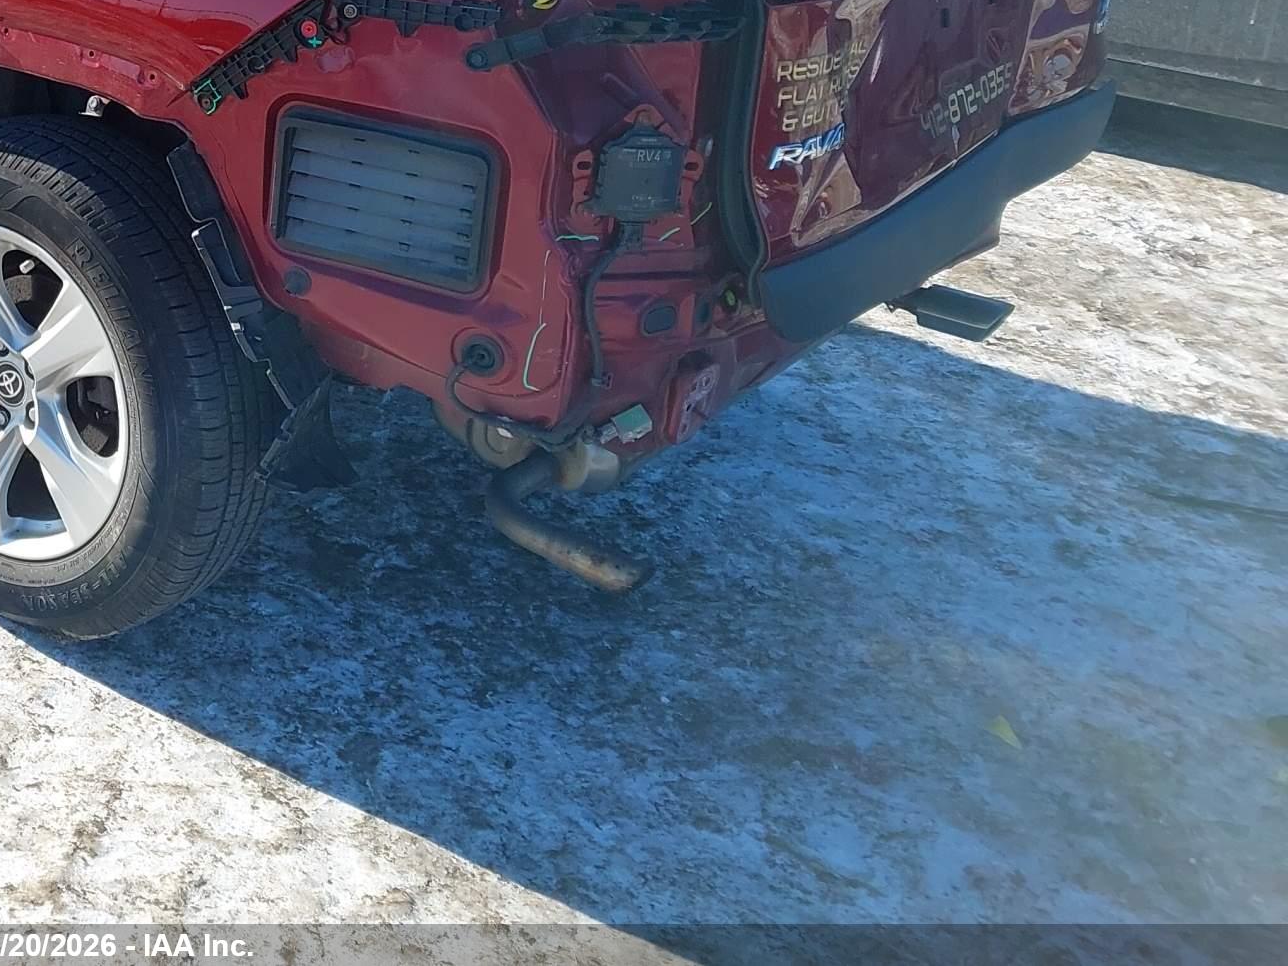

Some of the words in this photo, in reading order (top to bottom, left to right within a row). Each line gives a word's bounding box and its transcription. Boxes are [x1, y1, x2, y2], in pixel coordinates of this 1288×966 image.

[776, 78, 827, 109] FLAT
[782, 110, 800, 133] &
[768, 122, 845, 171] RAV4
